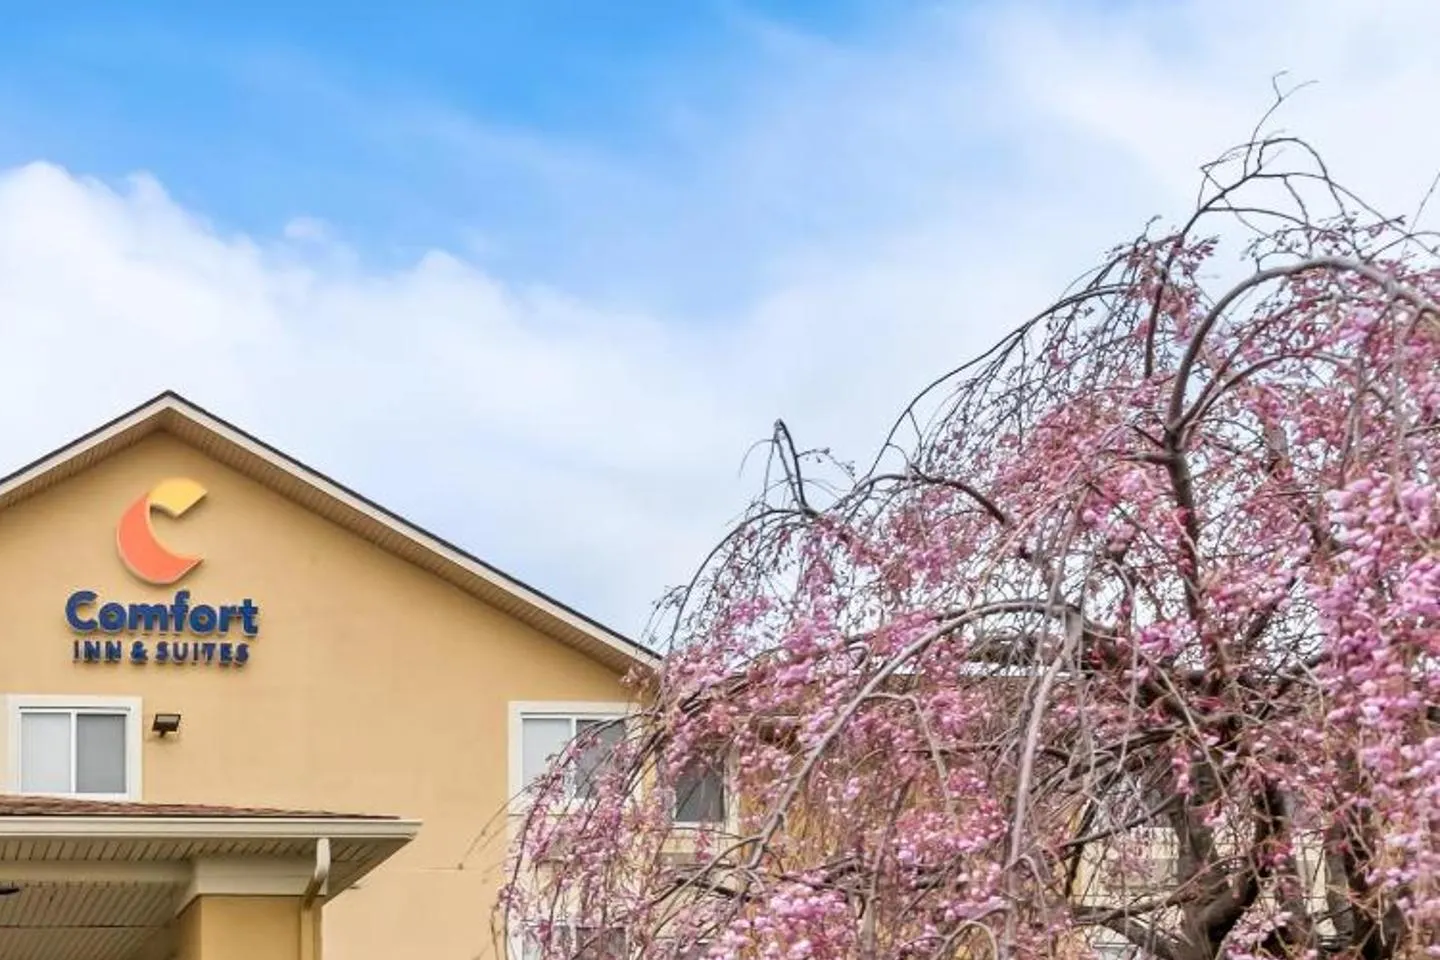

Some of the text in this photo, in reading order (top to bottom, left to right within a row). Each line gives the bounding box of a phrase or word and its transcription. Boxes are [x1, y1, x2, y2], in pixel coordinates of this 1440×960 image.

[65, 589, 259, 636] Comfort
[73, 640, 250, 666] INN & SUITES
